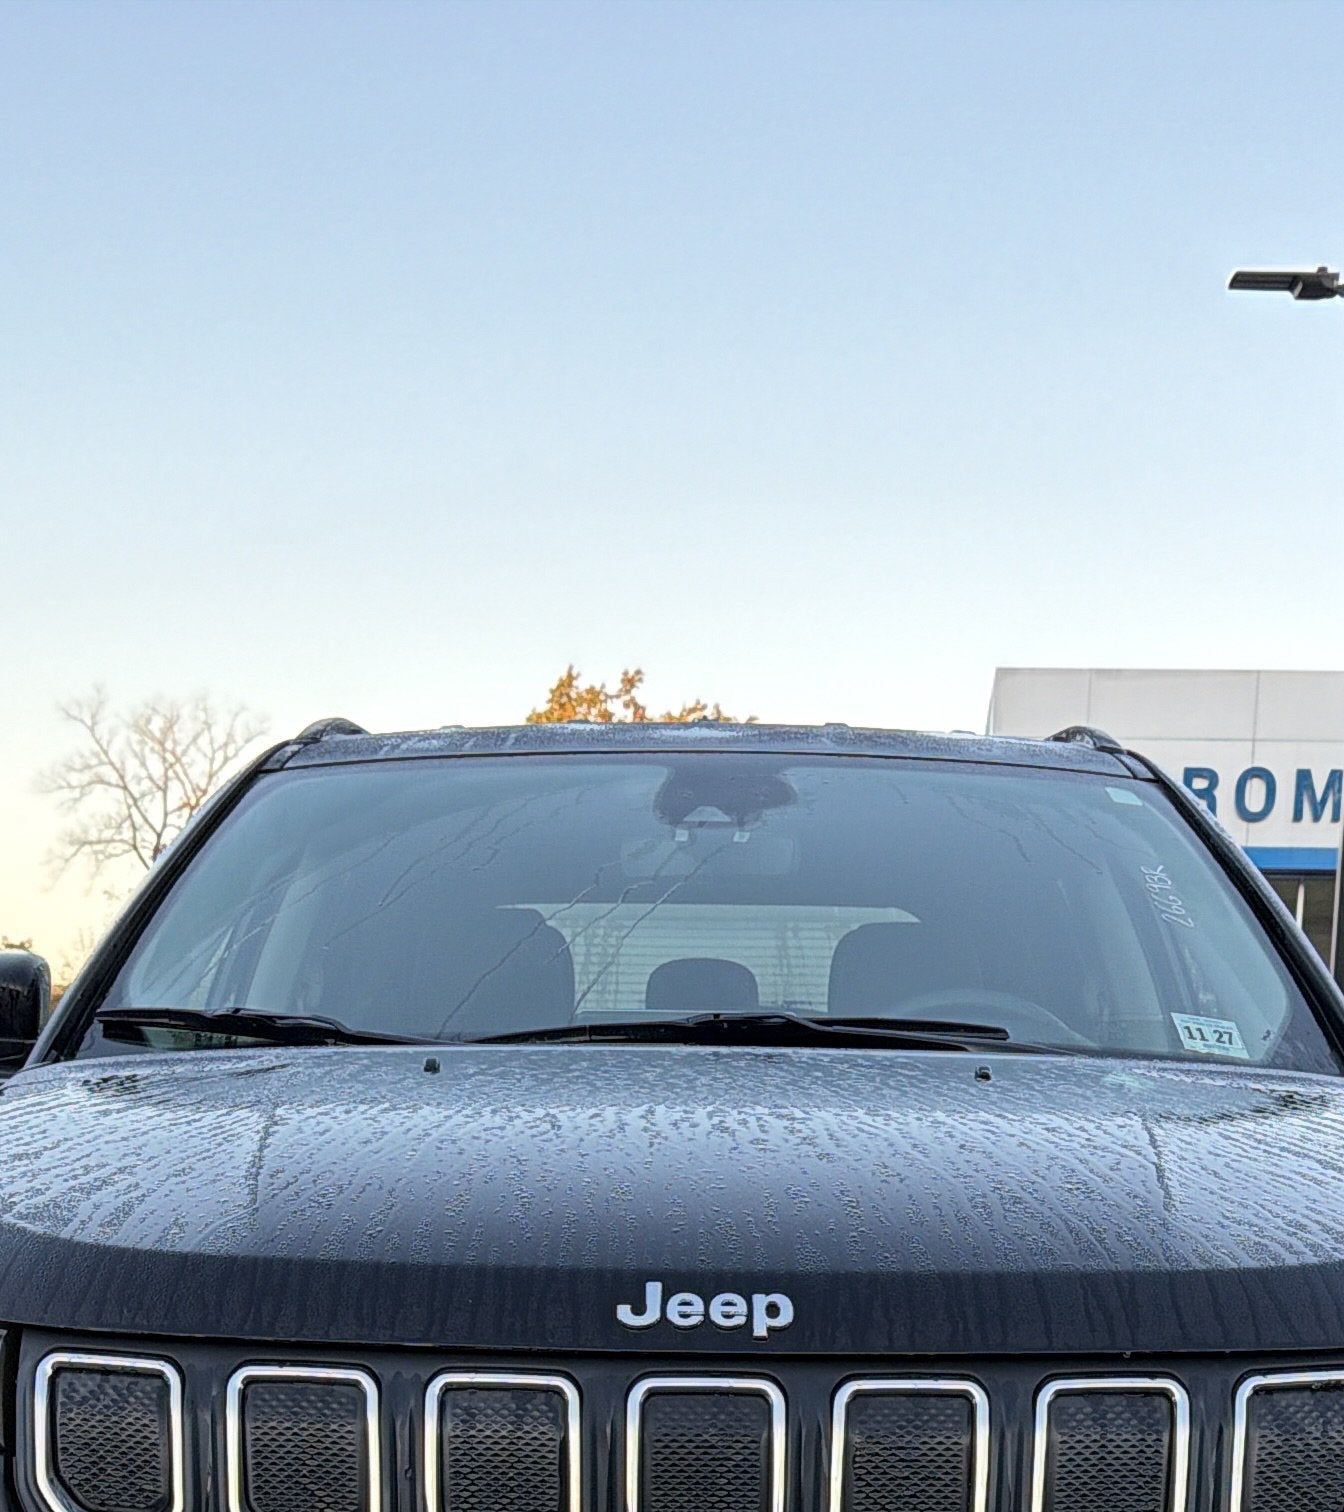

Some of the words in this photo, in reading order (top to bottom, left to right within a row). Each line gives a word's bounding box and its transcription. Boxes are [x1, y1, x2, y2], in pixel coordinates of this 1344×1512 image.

[1184, 1025, 1209, 1042] 11
[1213, 1029, 1233, 1045] 27
[616, 1281, 794, 1339] Jeep
